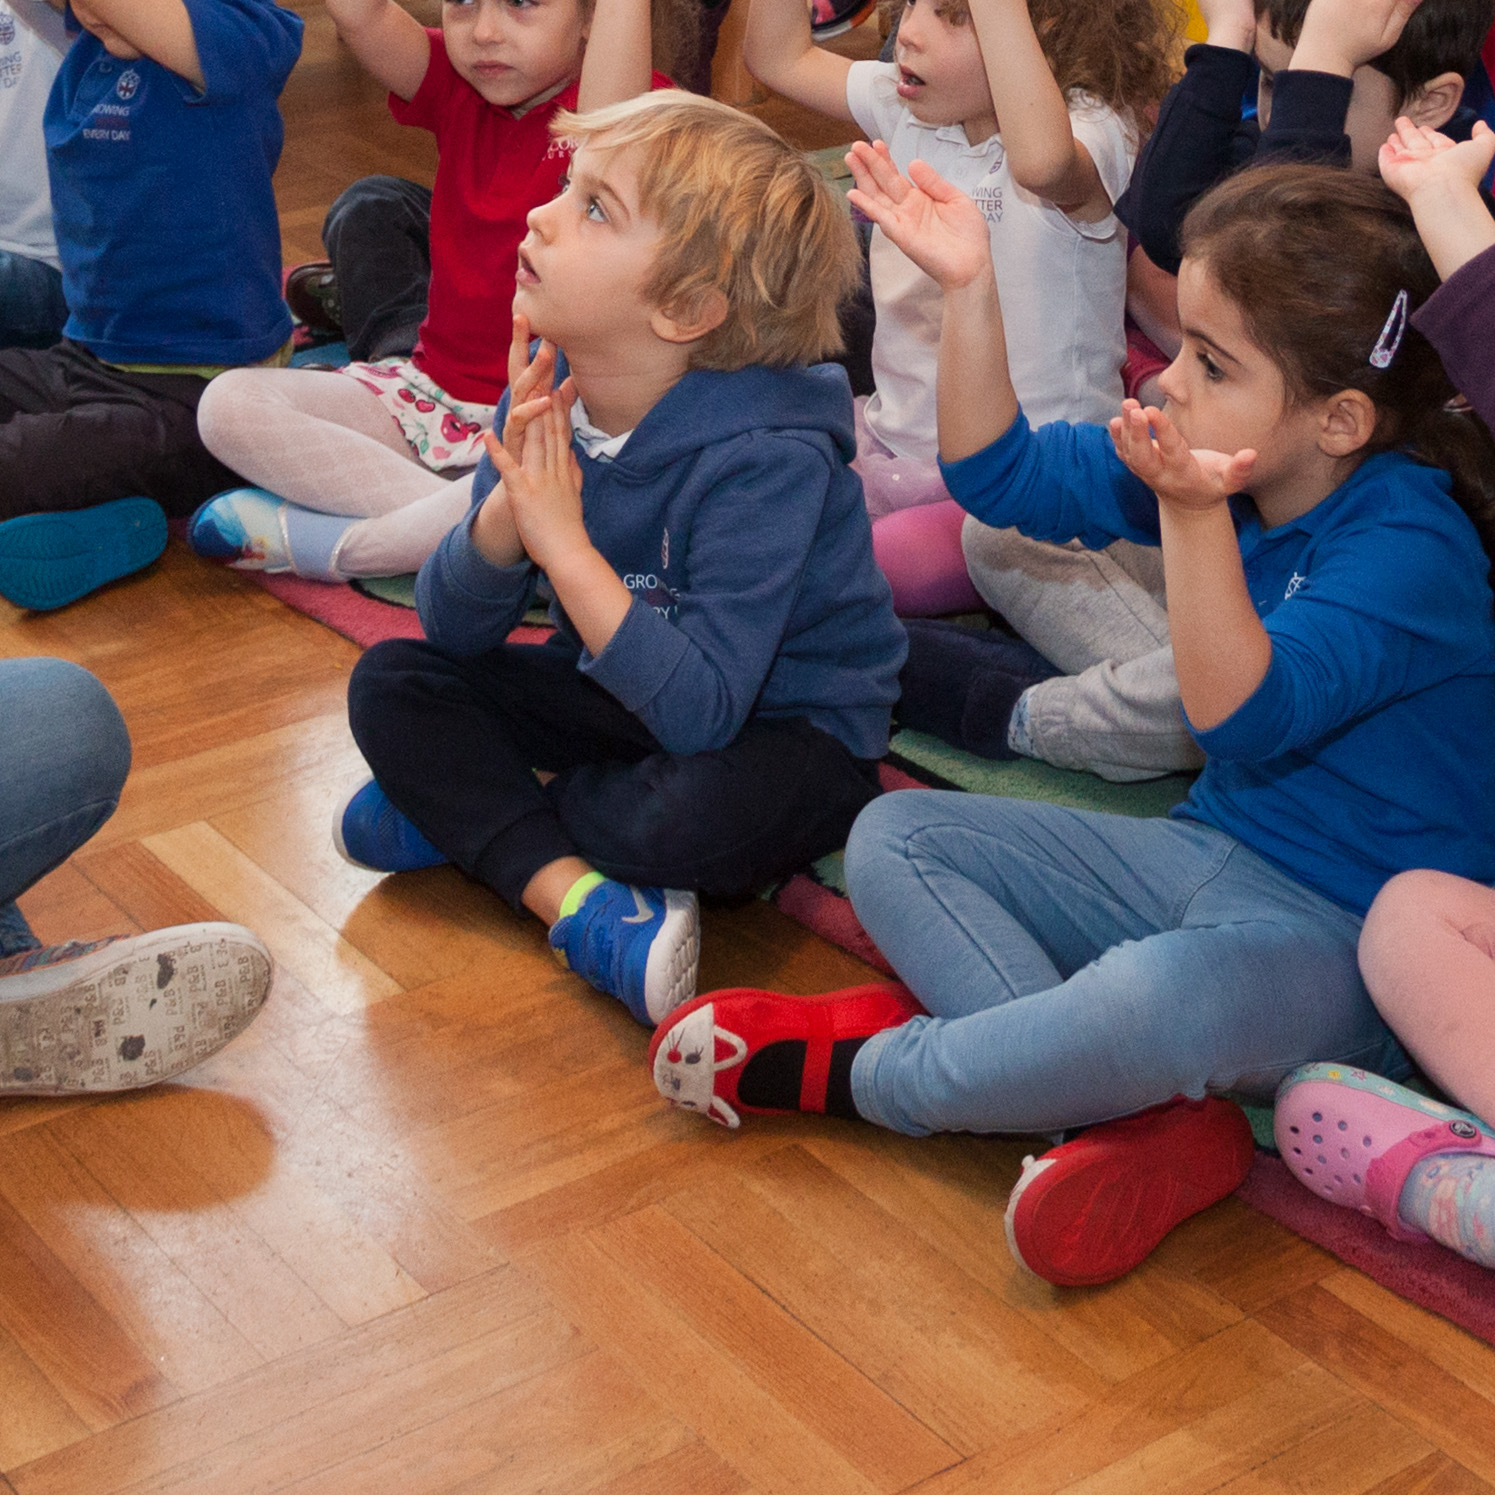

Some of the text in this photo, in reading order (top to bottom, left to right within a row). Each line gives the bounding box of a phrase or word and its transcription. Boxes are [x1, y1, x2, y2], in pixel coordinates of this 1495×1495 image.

[82, 128, 131, 141] EVERY DAY
[982, 212, 1003, 223] AY
